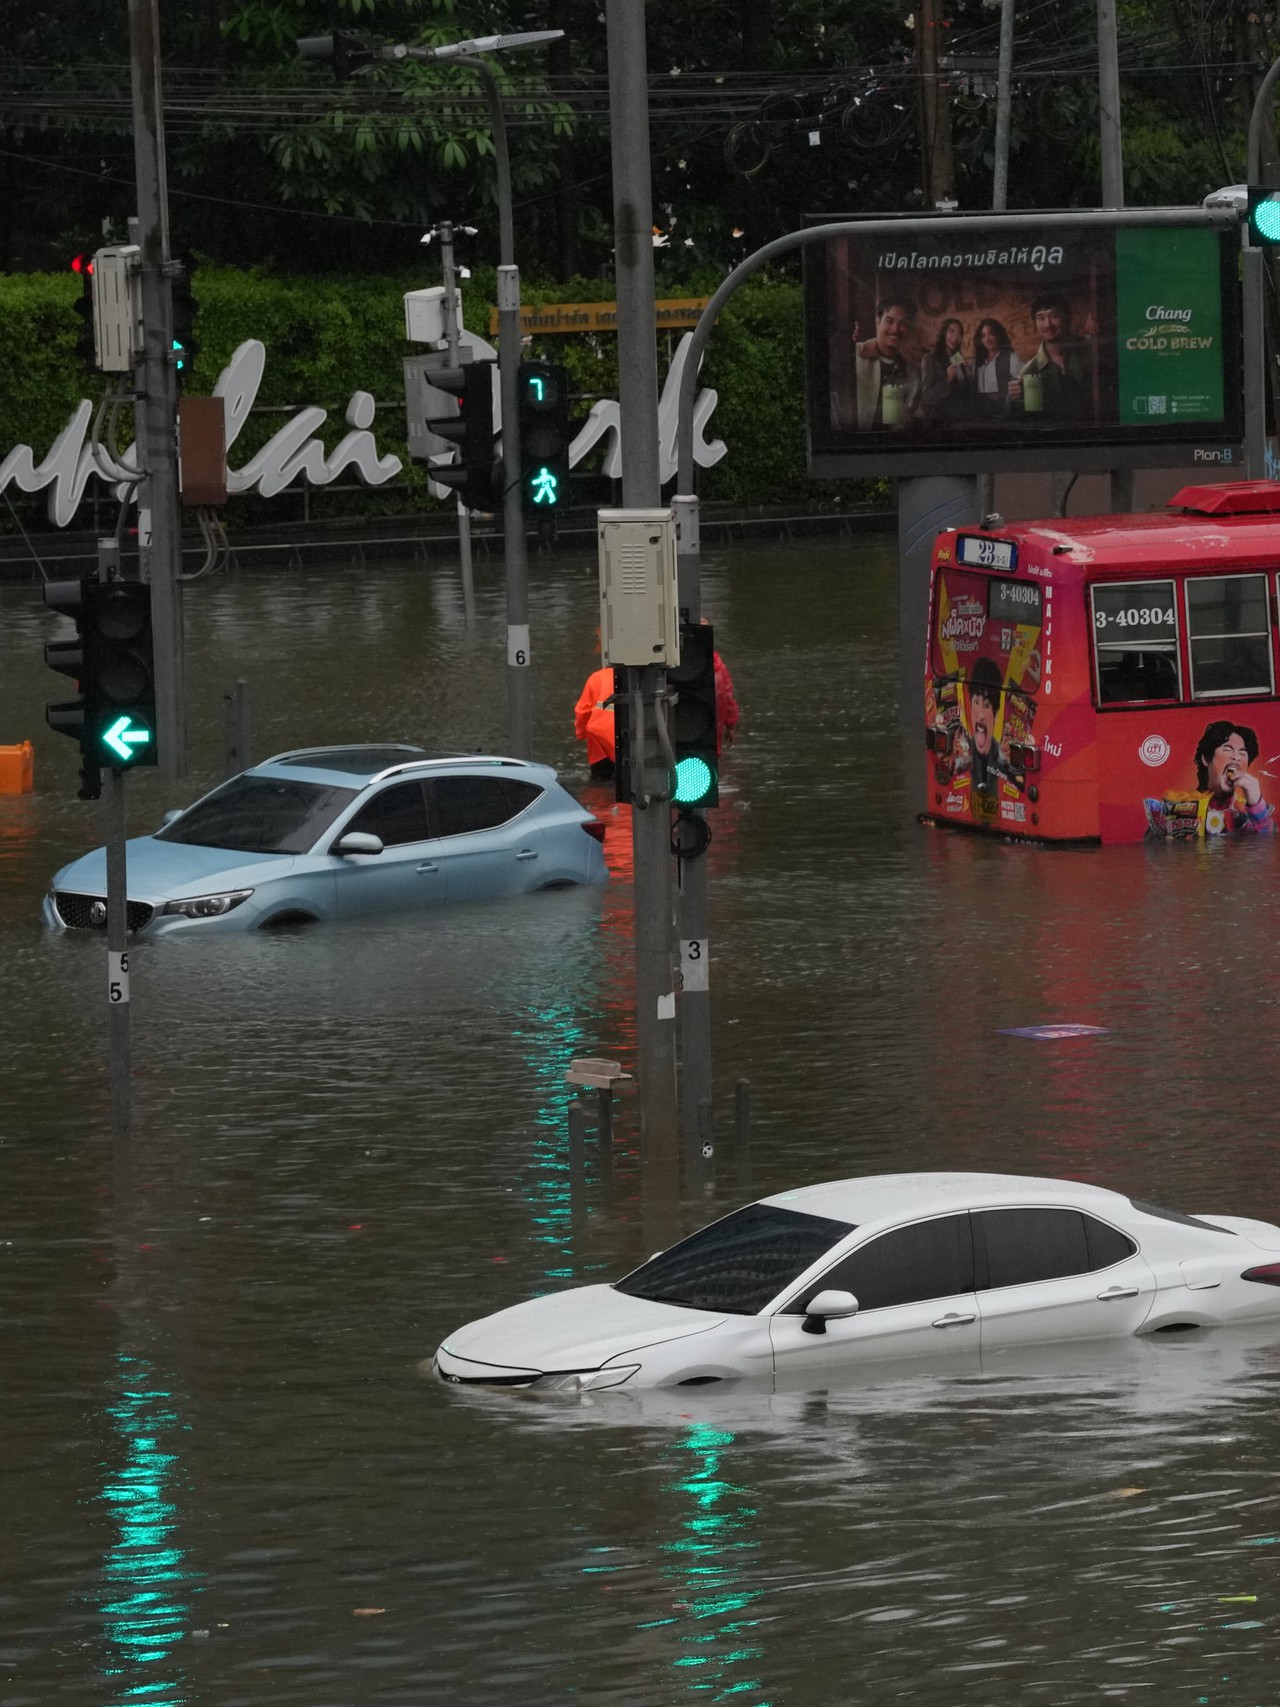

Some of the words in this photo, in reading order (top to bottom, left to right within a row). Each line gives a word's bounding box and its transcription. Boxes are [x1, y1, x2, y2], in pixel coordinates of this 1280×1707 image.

[1146, 306, 1192, 322] Chang
[1126, 337, 1168, 350] COLD
[1171, 336, 1214, 349] BREW
[529, 378, 543, 401] 7
[1001, 584, 1040, 606] 3-40304
[1096, 608, 1175, 628] 3-40304
[516, 650, 526, 665] 6
[1044, 735, 1062, 757] ใหม่
[688, 941, 701, 960] 3
[110, 982, 122, 1002] 5
